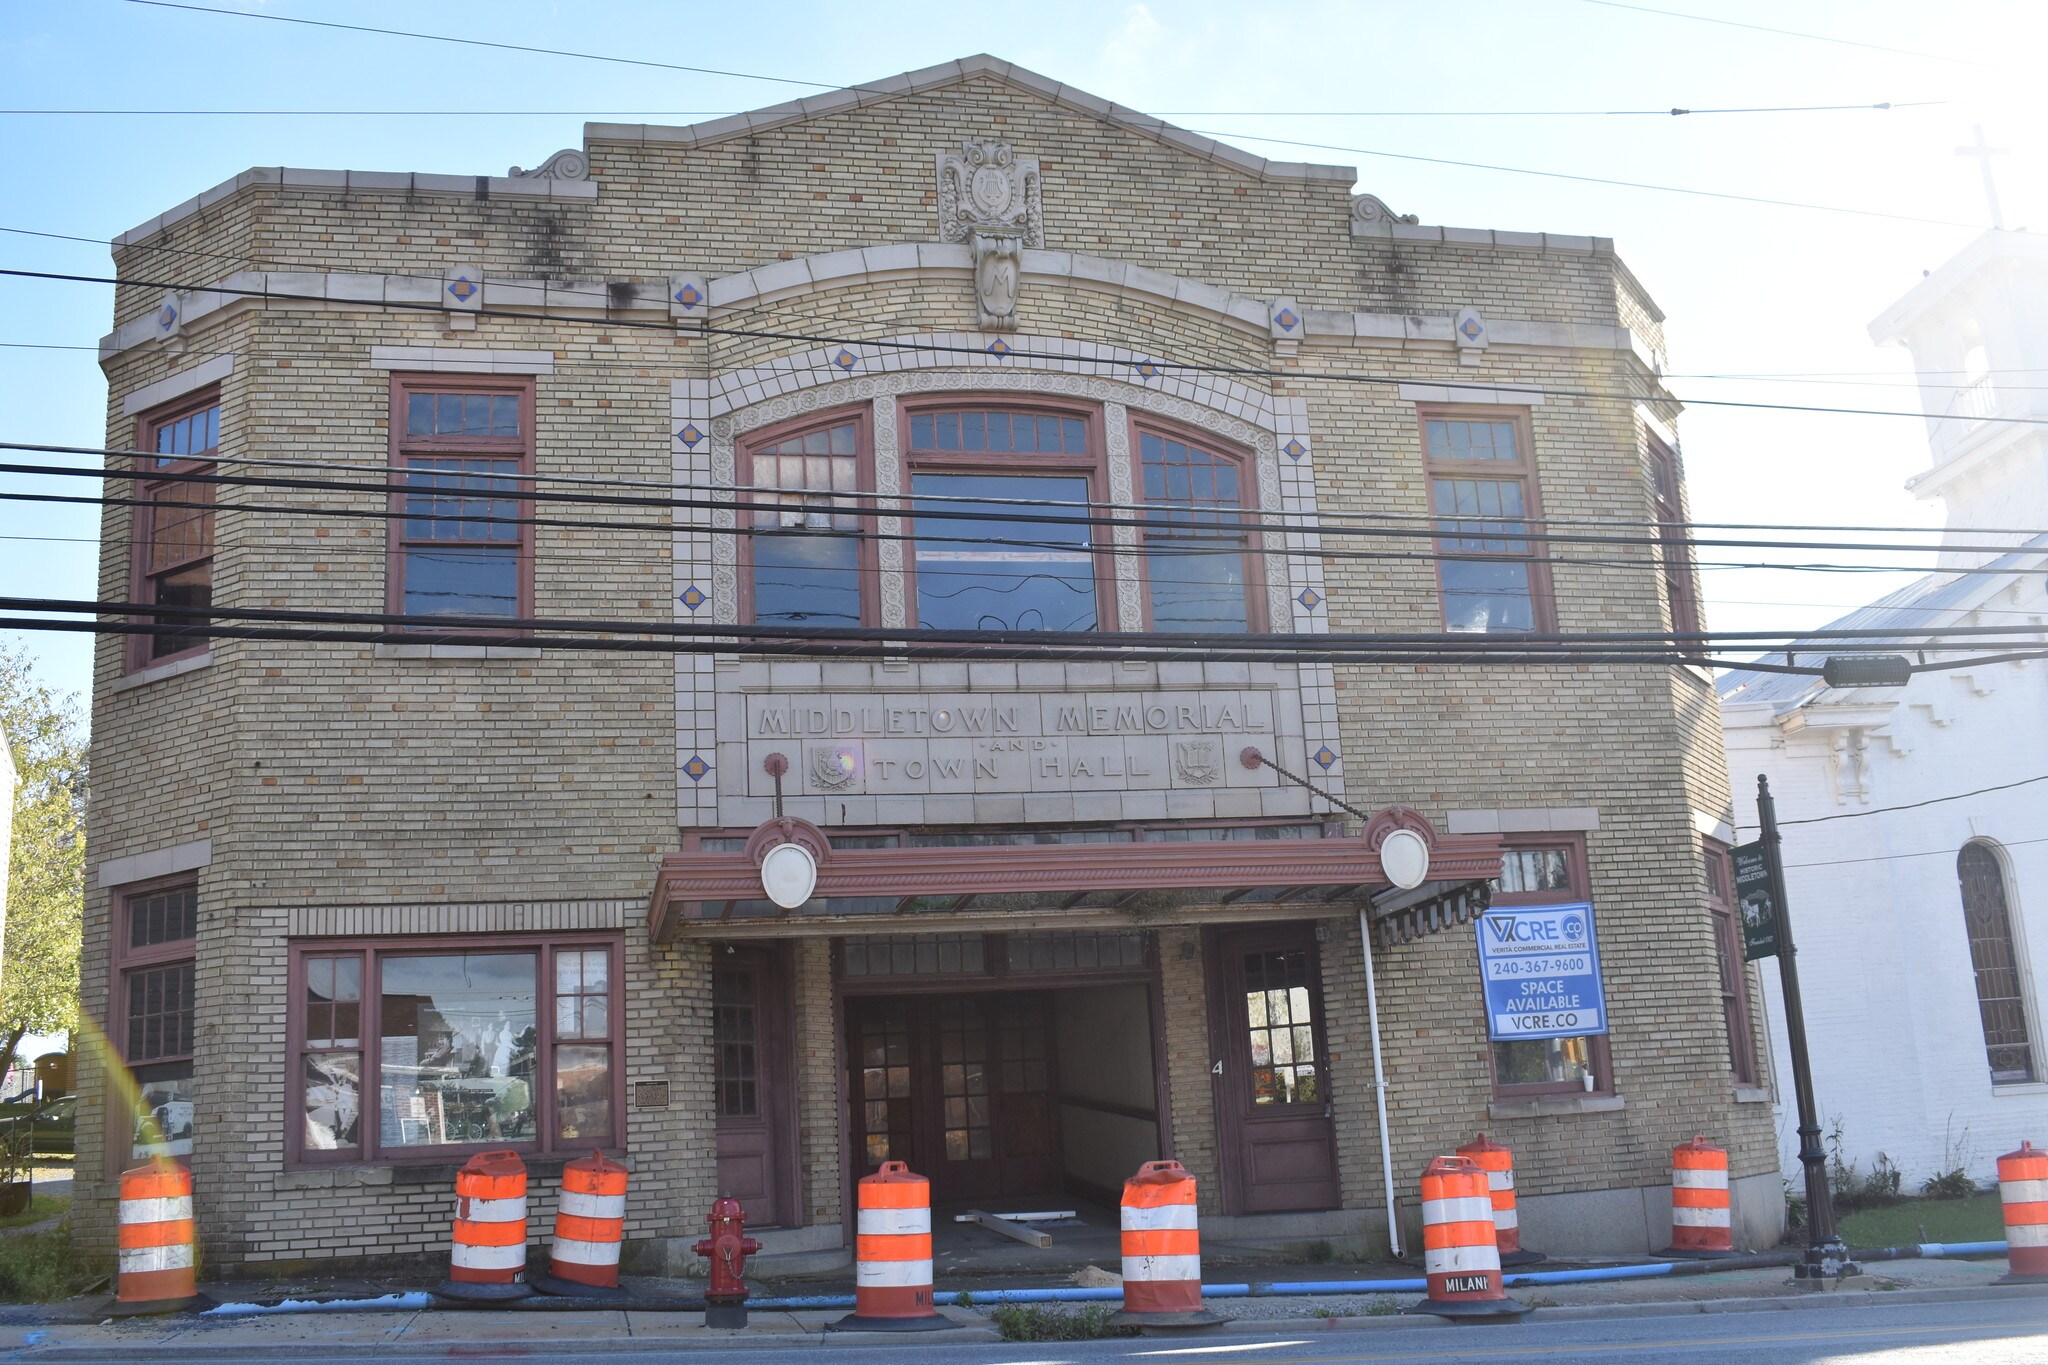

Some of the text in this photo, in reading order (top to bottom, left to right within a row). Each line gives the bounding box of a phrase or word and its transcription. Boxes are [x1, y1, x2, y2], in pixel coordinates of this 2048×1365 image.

[984, 264, 1014, 298] M
[759, 704, 1264, 734] MIDDLETOWN MEMORIAL
[873, 755, 1150, 780] TOWN HALL
[1736, 870, 1768, 884] MIDDLETOWN
[1740, 863, 1763, 875] HISTORIC
[1513, 944, 1553, 953] COMMERCIAL
[1568, 942, 1586, 950] ESTATE
[1494, 958, 1584, 975] 240-367-9600
[1521, 980, 1564, 995] SPACE
[1506, 995, 1580, 1012] AVAILABLE
[1511, 1013, 1578, 1030] VCRE.CO
[1211, 1060, 1223, 1075] 4
